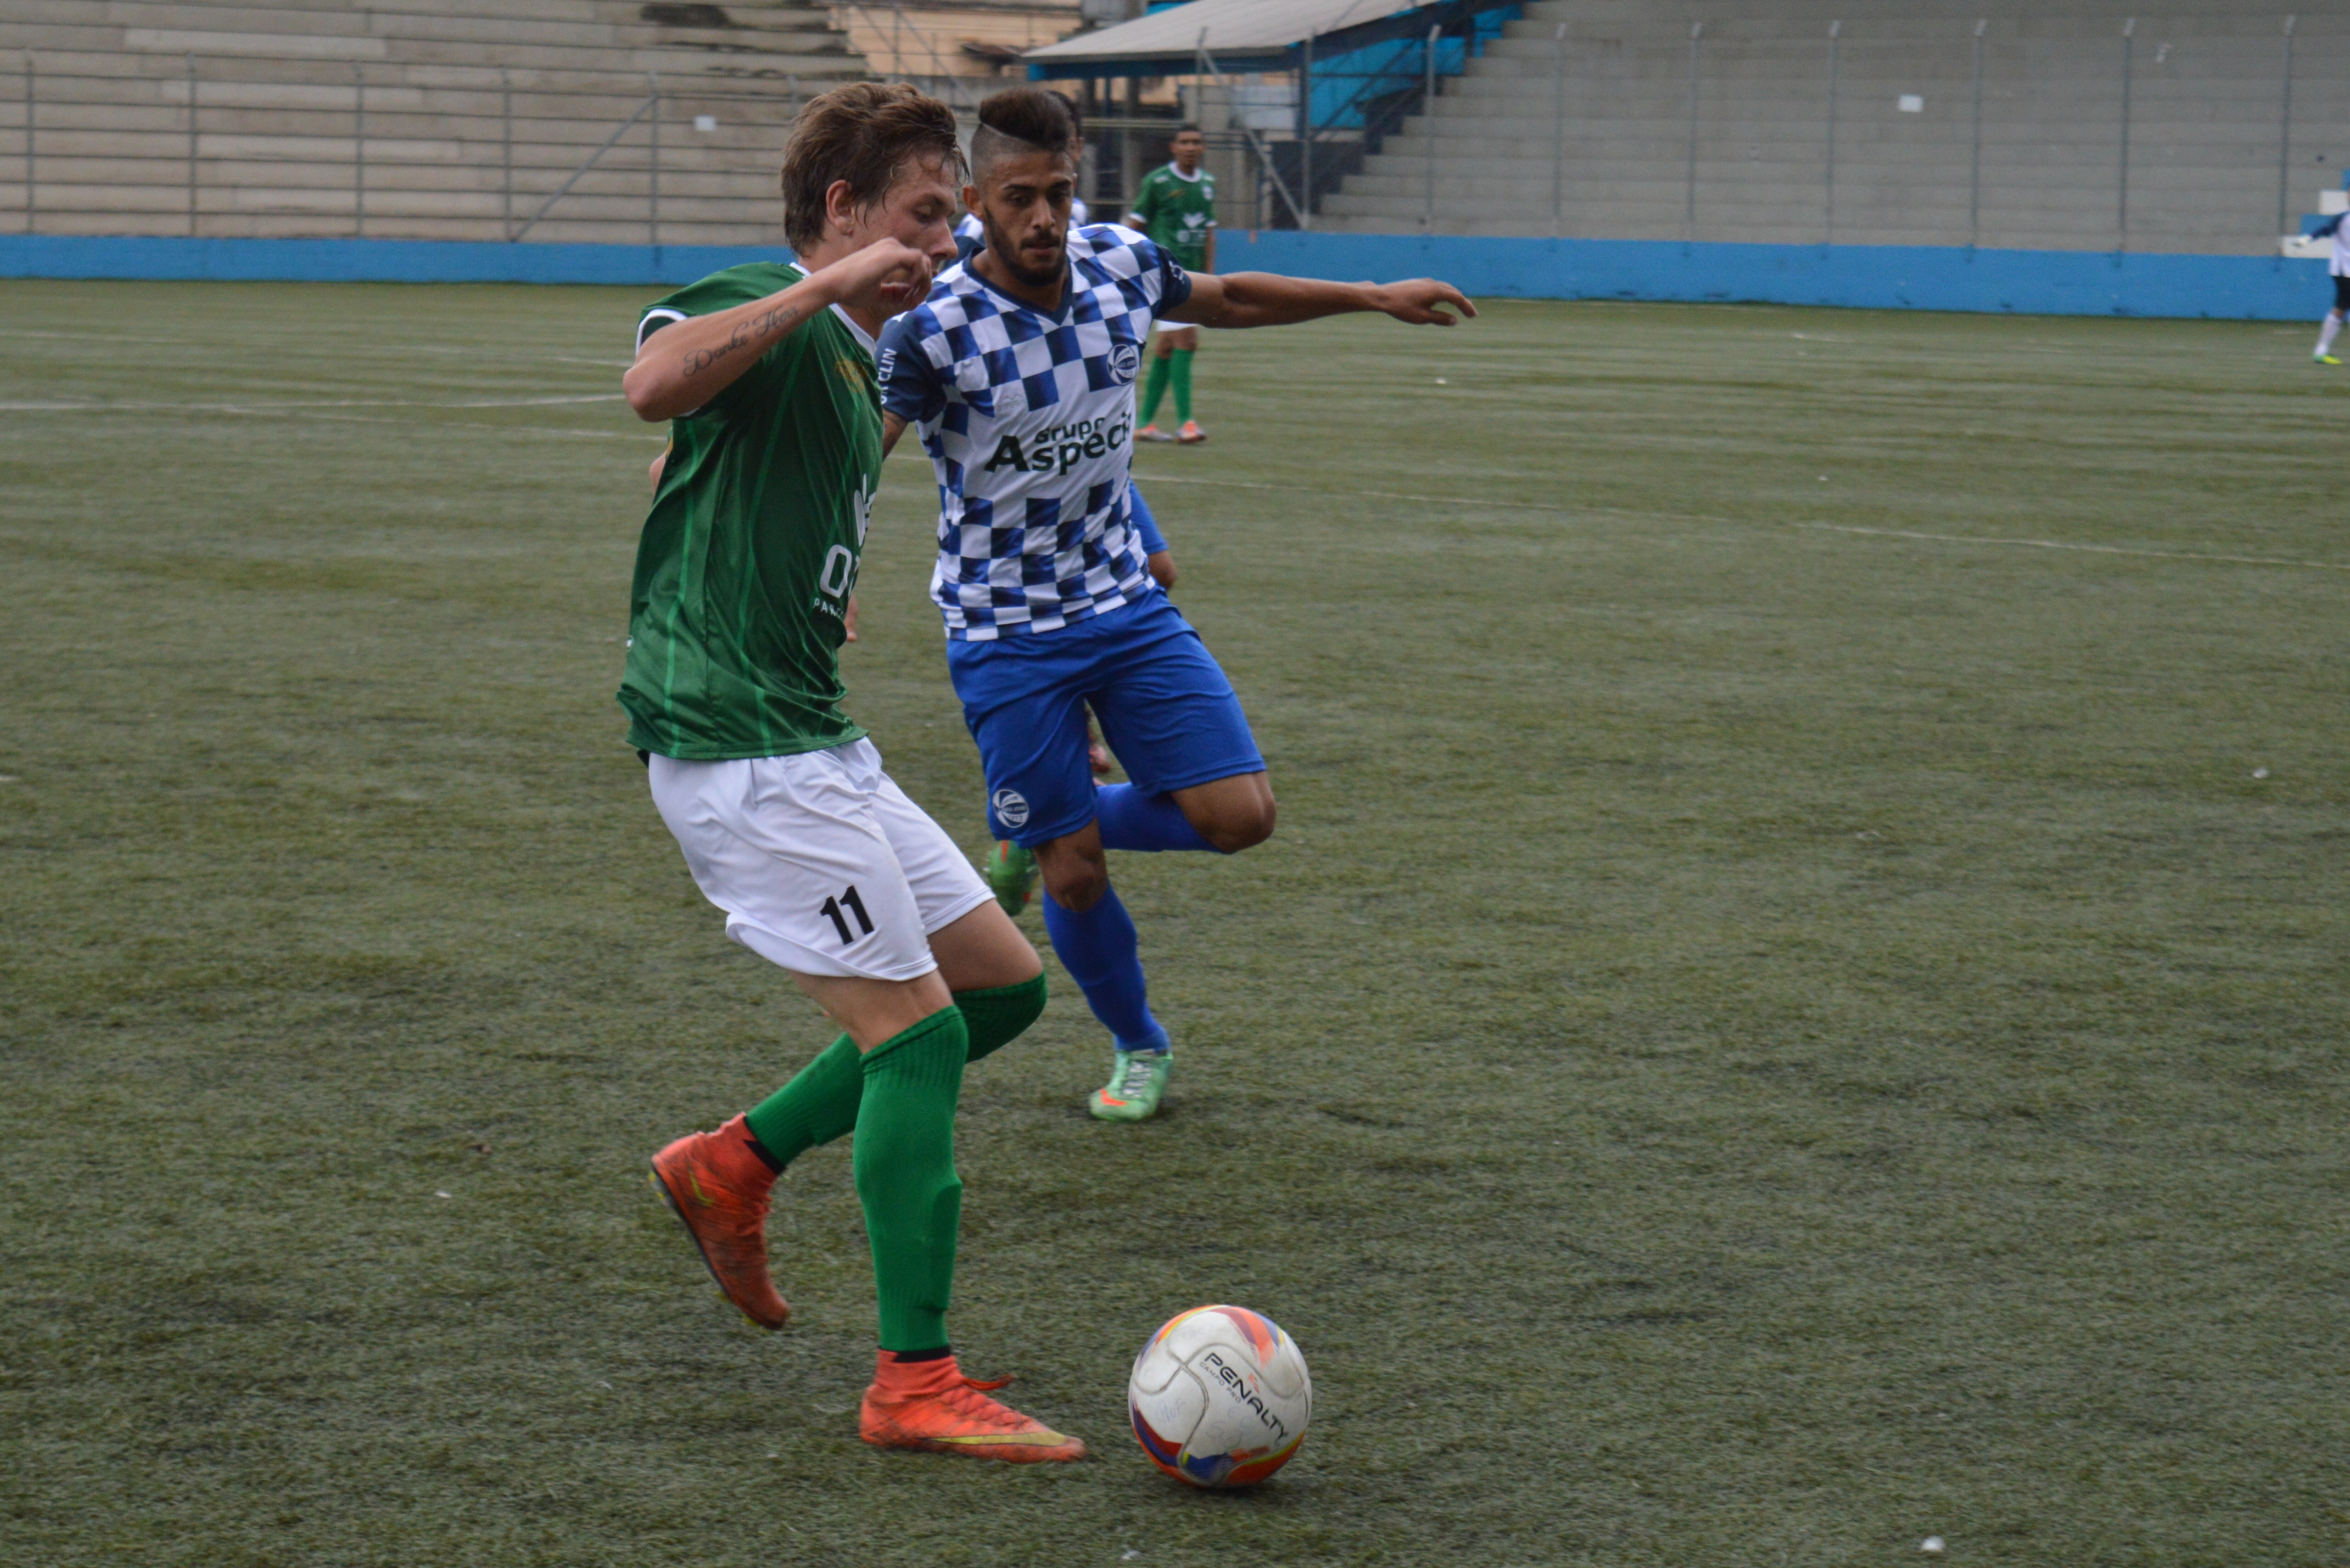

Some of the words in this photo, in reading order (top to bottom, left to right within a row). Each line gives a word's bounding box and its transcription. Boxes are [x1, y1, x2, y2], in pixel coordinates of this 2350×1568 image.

[878, 347, 897, 381] CLIN
[1034, 417, 1105, 444] Grupo
[820, 885, 875, 946] 11
[1199, 1361, 1225, 1386] CAMPO
[1226, 1387, 1242, 1403] PRO
[1204, 1352, 1289, 1439] PENALTY
